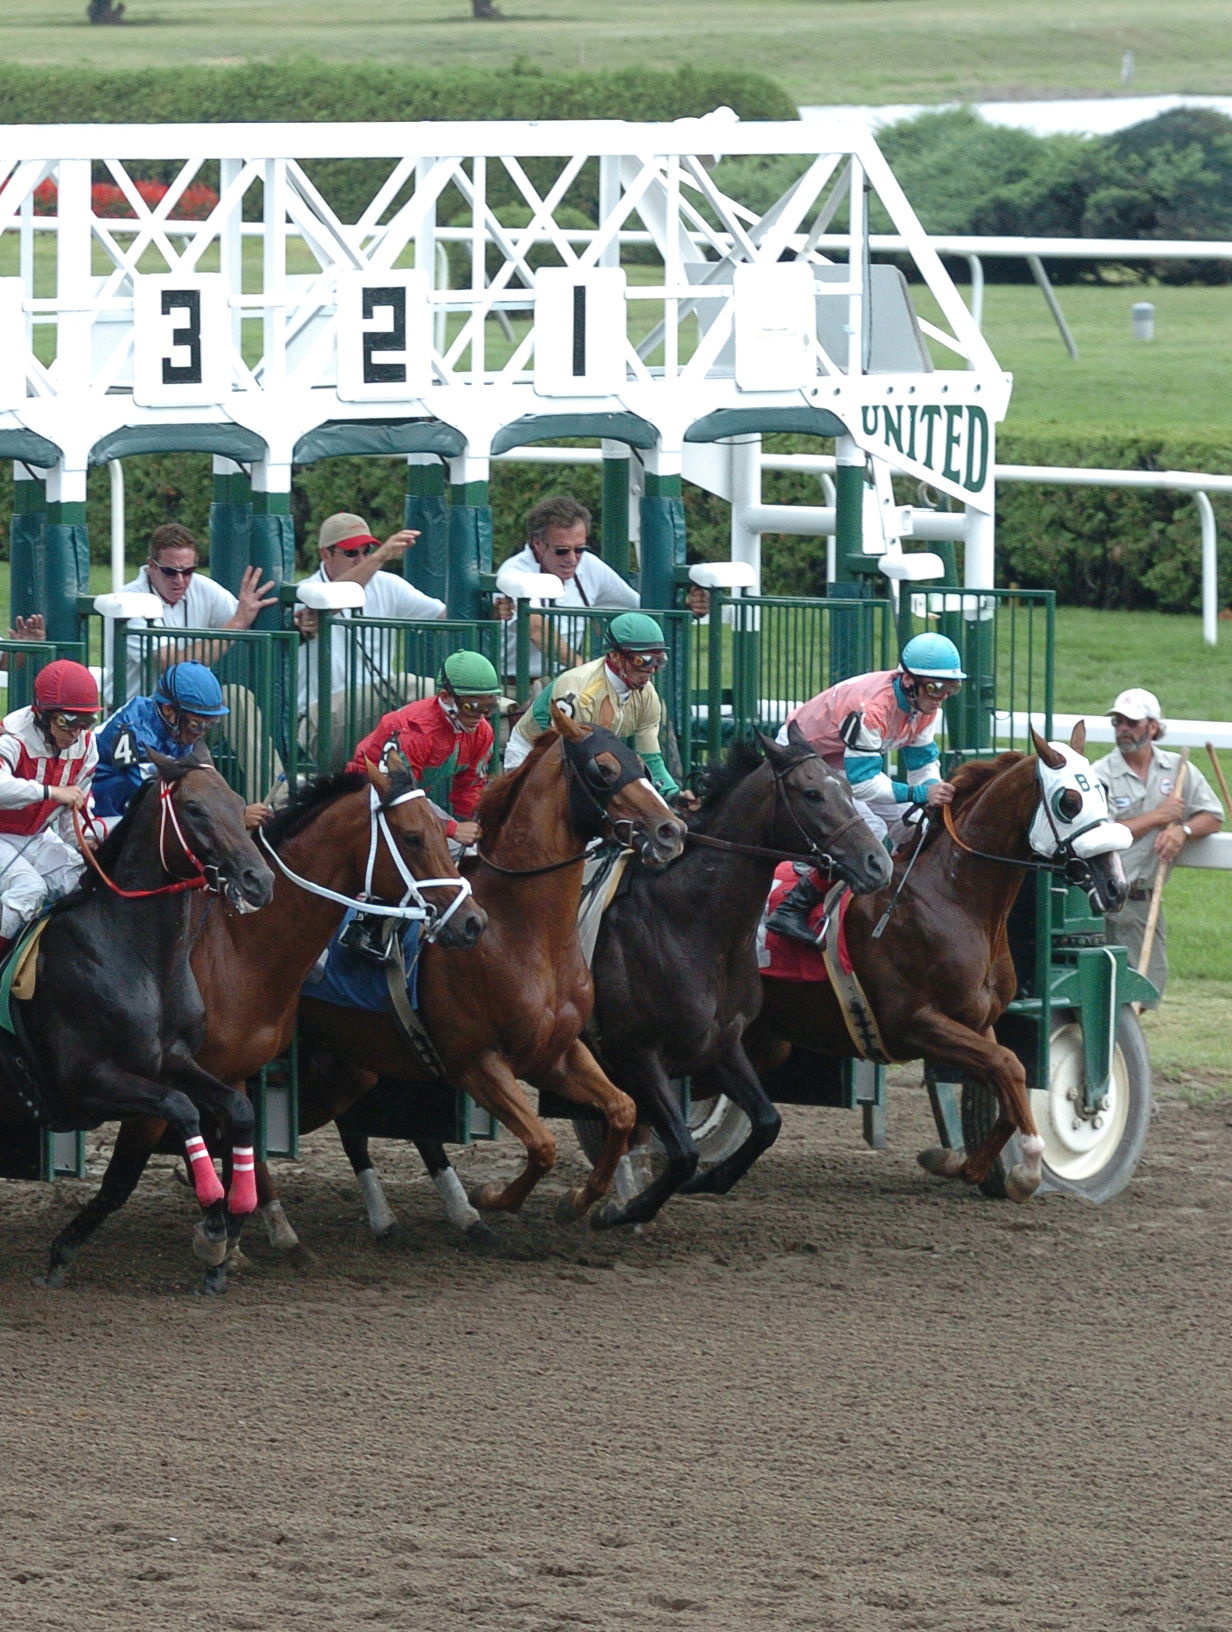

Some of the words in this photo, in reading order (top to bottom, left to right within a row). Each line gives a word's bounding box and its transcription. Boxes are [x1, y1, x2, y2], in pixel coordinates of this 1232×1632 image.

[162, 290, 202, 384] 3
[363, 287, 407, 383] 2
[573, 286, 586, 377] 1
[861, 404, 989, 493] UNITED
[114, 733, 133, 764] 4
